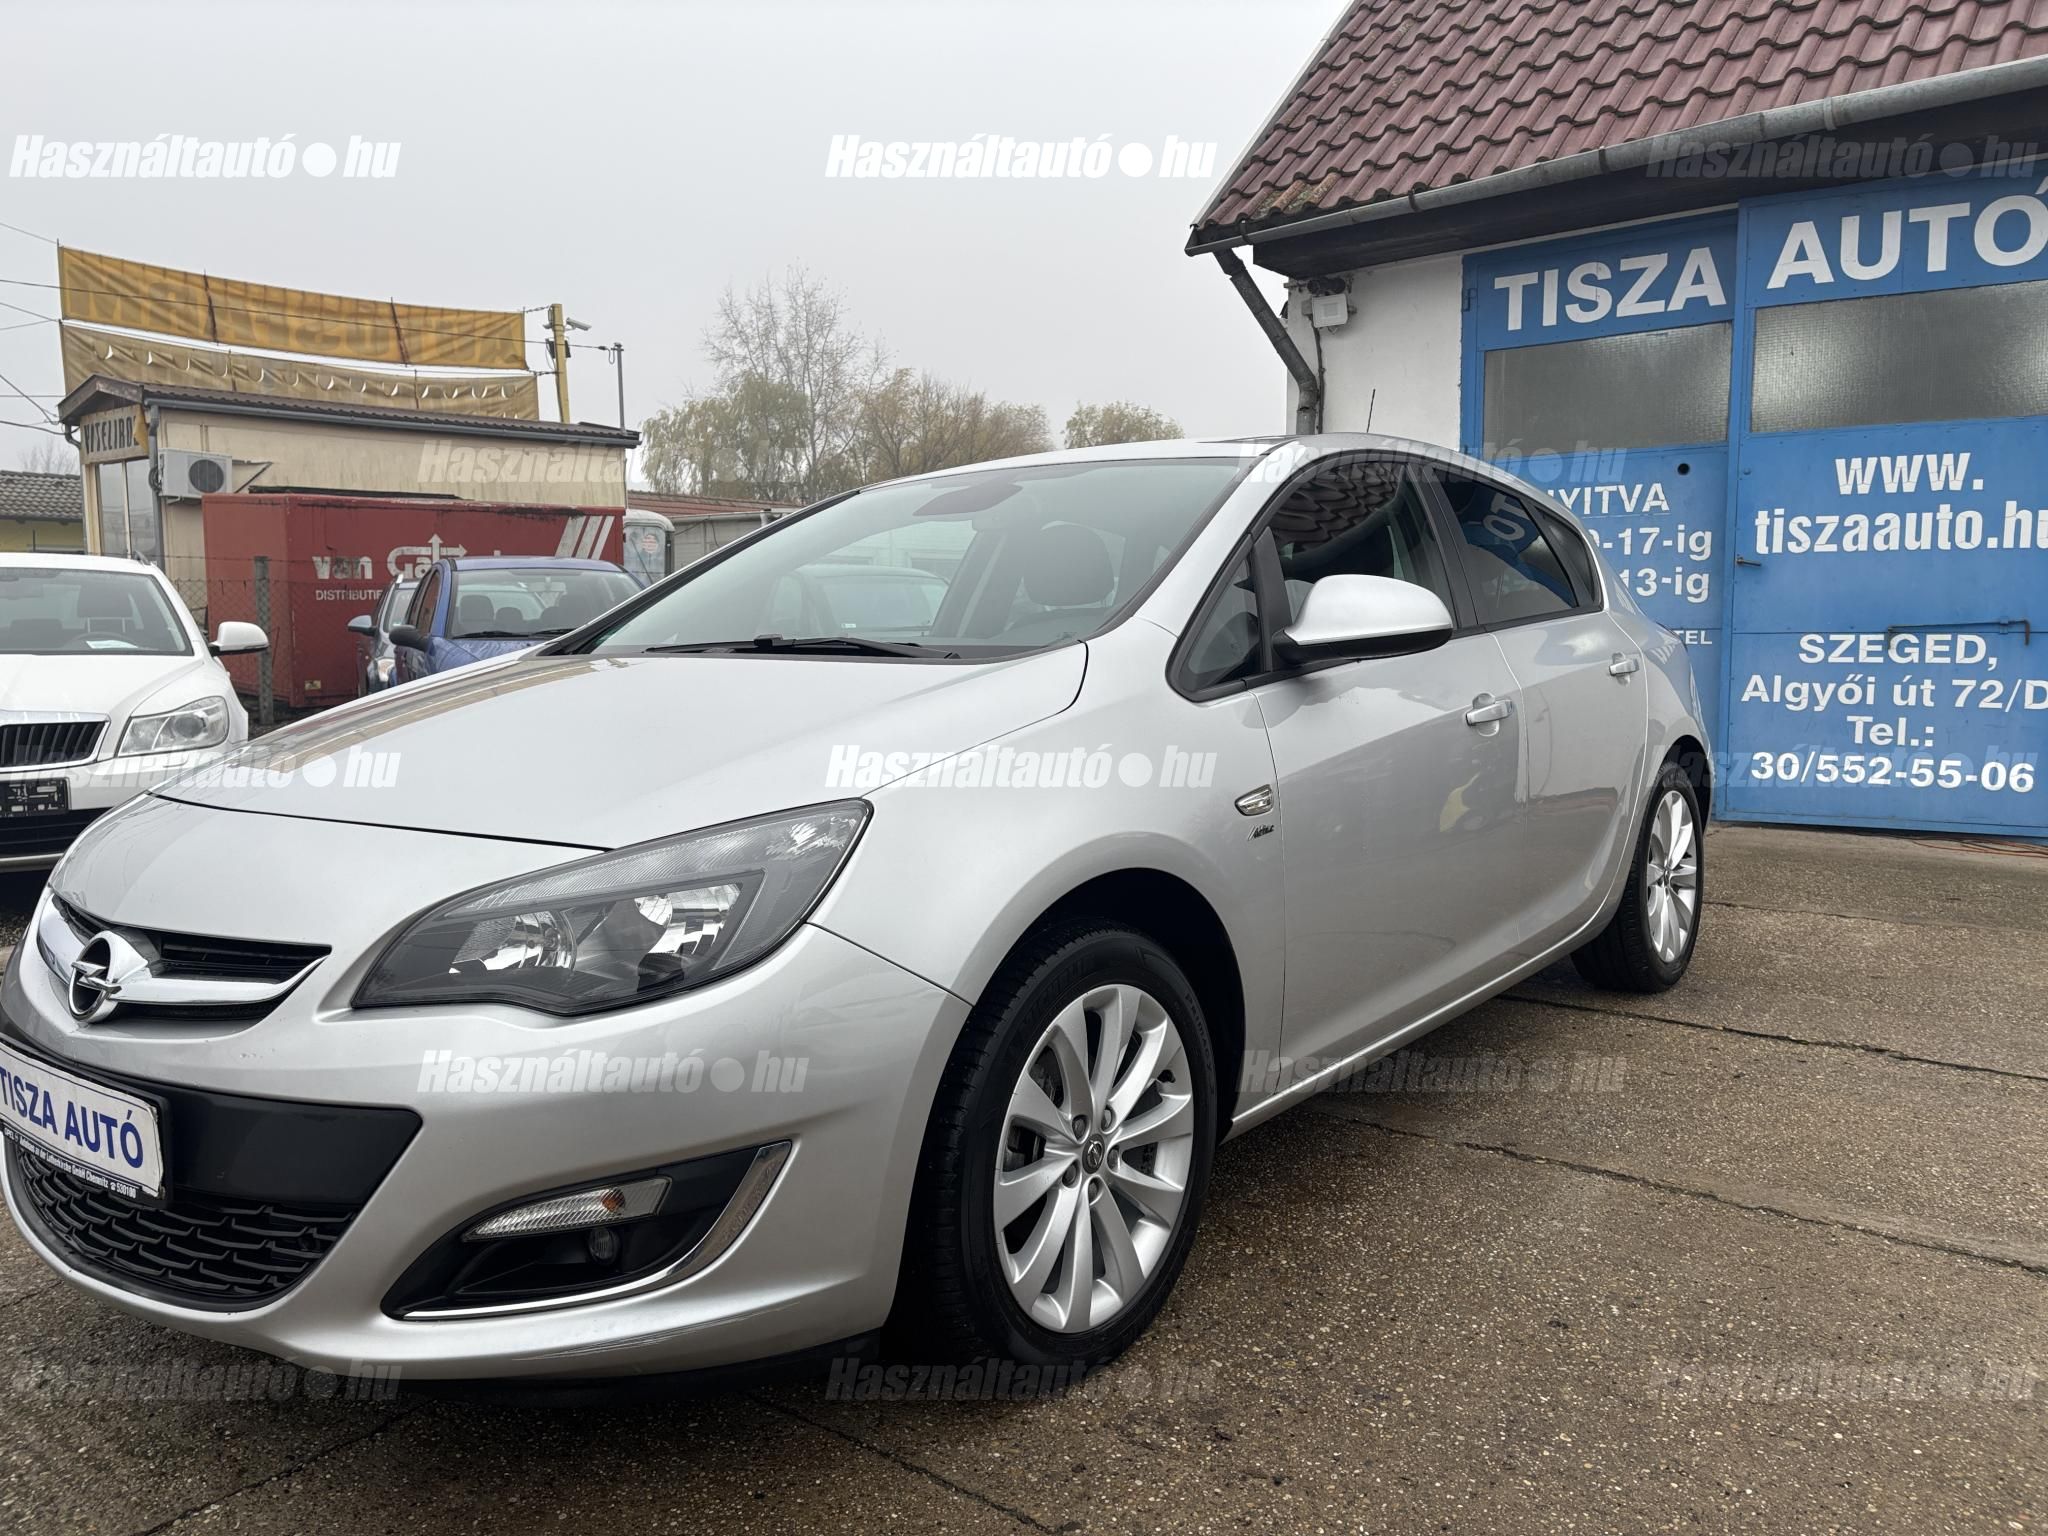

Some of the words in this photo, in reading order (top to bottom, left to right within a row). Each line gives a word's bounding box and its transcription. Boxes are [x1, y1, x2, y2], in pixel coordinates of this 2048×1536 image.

[1494, 247, 1728, 331] TISZA
[1767, 176, 2048, 290] AUTÓ
[1547, 483, 1670, 515] YITVA
[1799, 634, 1998, 672] SZEGED,
[1741, 673, 1876, 712] Algyői
[1893, 677, 1935, 708] út
[1952, 679, 2048, 713] 72/D
[1847, 716, 1935, 748] Tel.:
[1751, 752, 2035, 793] 30/552-55-06
[0, 1066, 58, 1135] TISZA
[64, 1101, 144, 1169] AUTÓ
